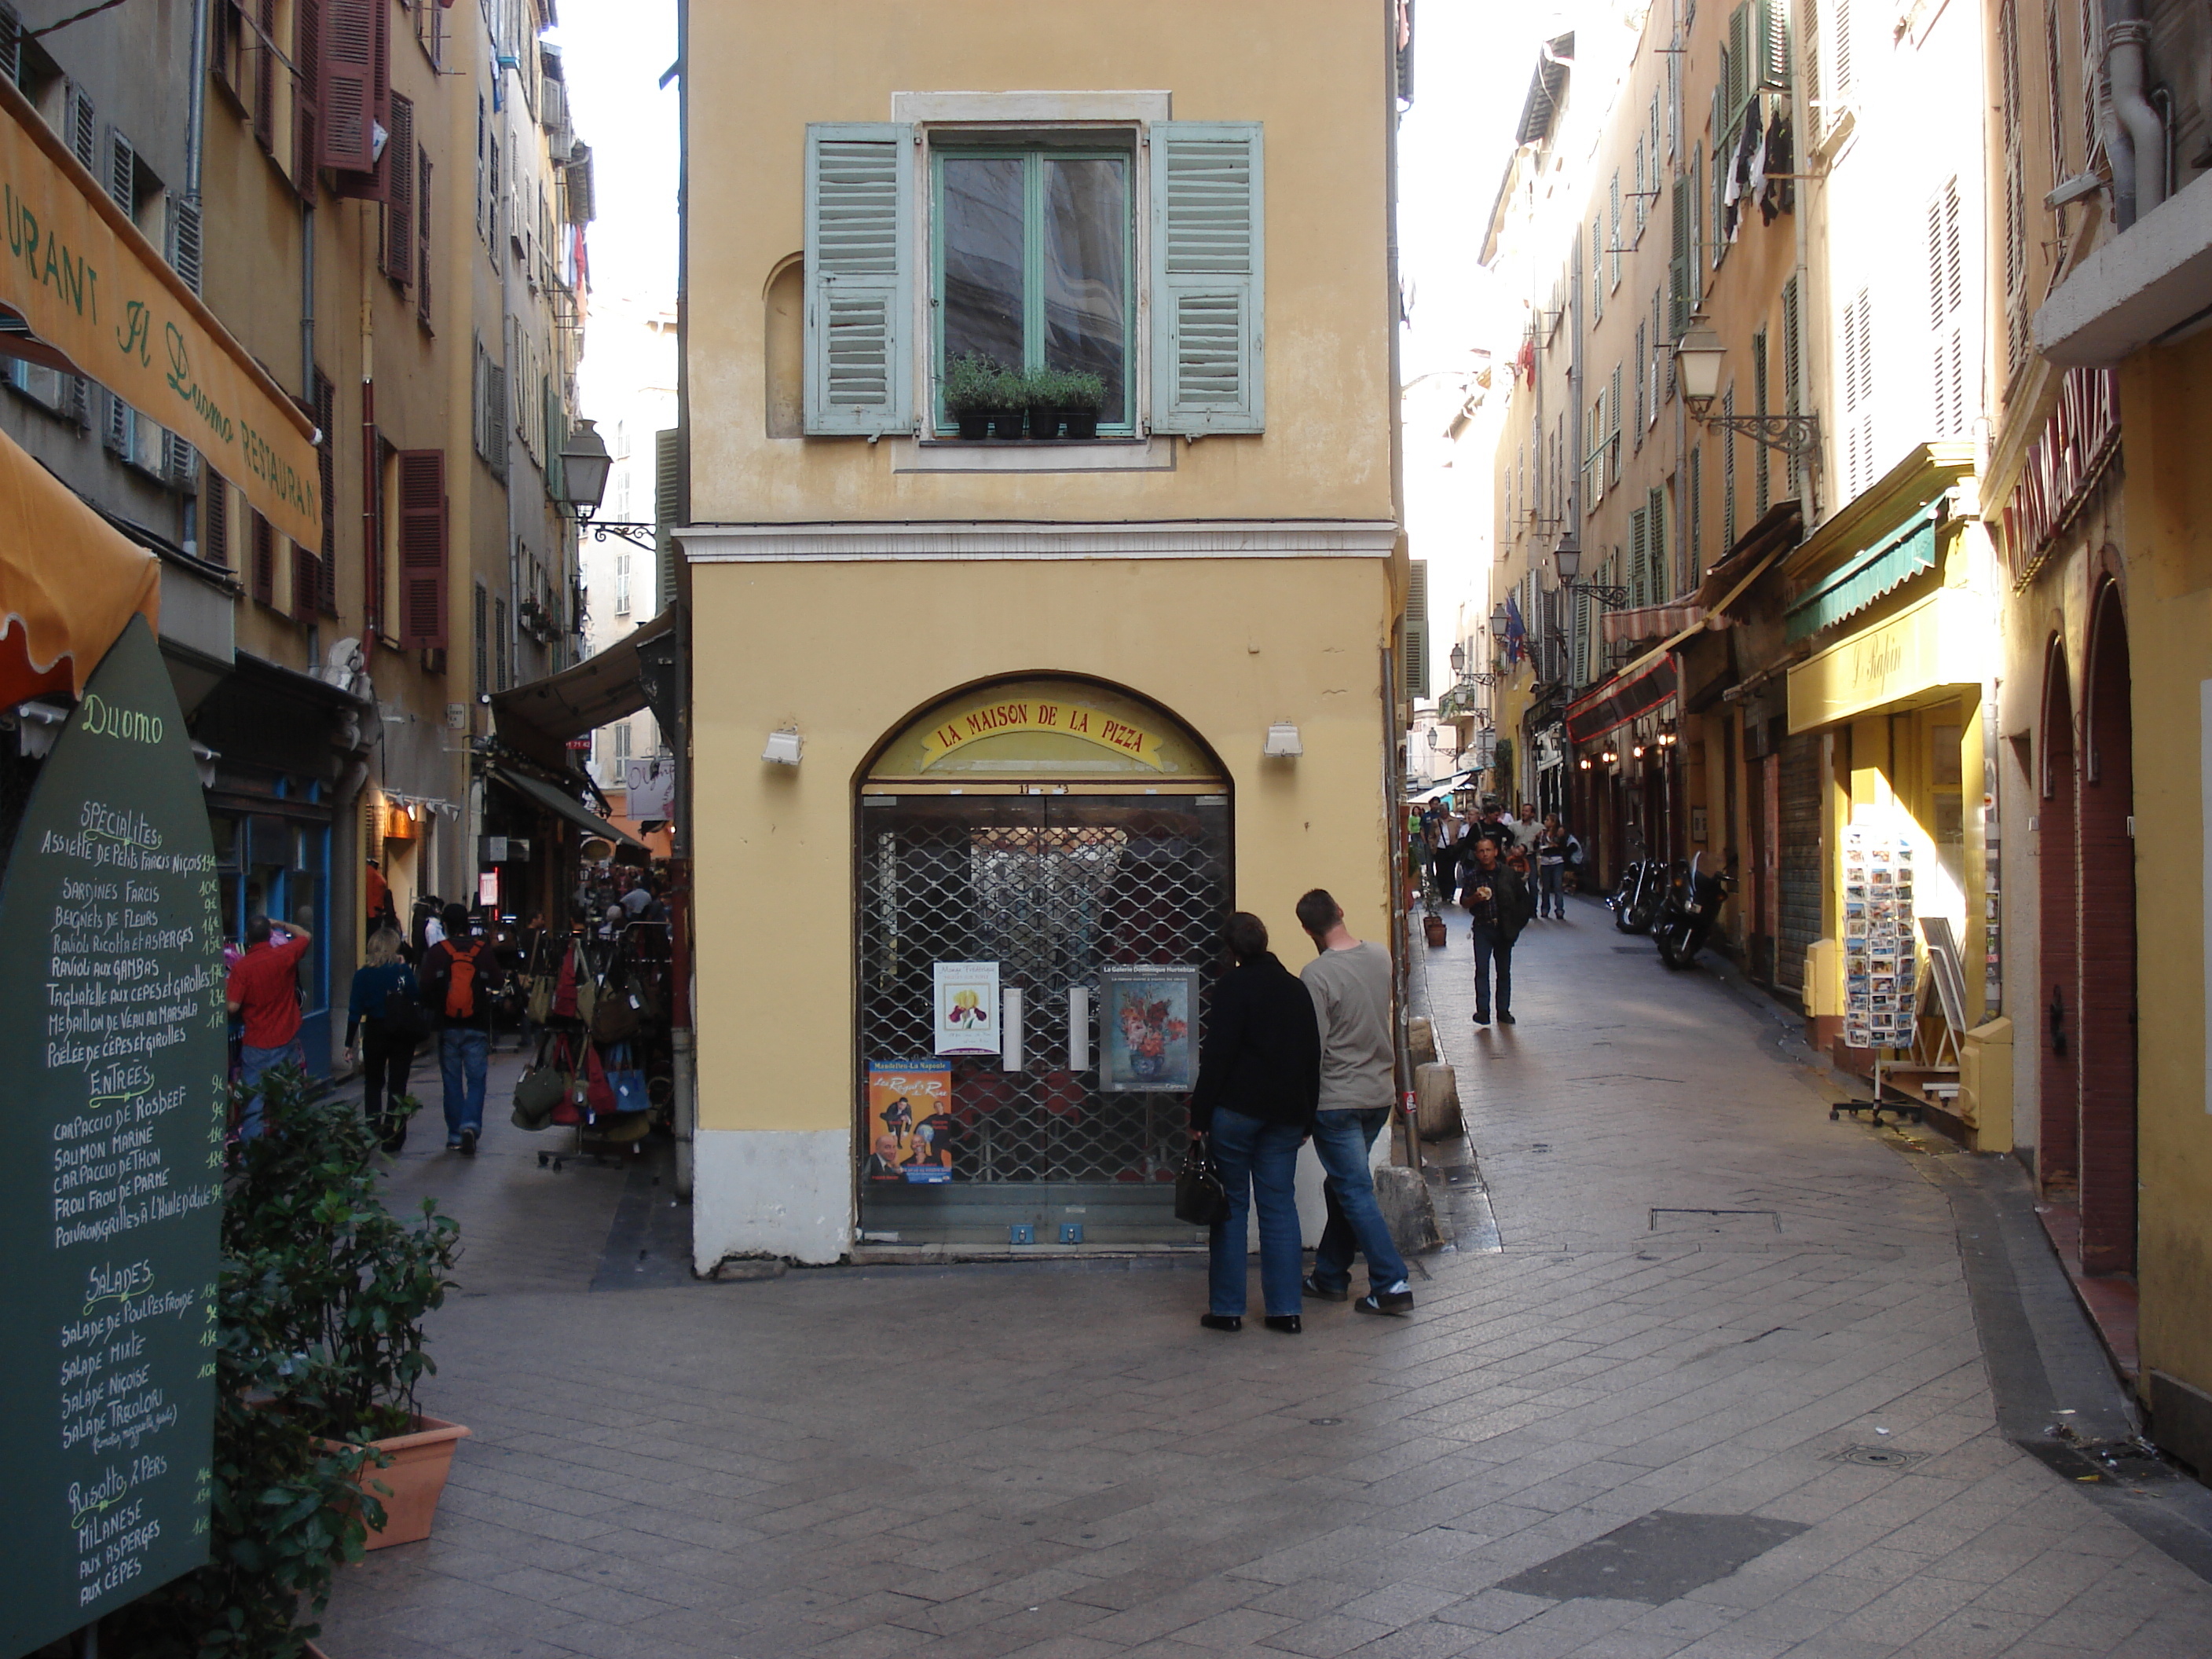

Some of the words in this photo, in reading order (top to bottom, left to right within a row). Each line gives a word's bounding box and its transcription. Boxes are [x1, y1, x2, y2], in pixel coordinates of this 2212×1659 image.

[0, 183, 97, 326] URANT
[166, 320, 234, 444] Duomo
[937, 723, 962, 748] LA
[966, 704, 1027, 735] MAISON
[1038, 705, 1058, 726] DE
[1069, 710, 1089, 733] LA
[1101, 720, 1144, 753] PIZZA
[96, 843, 110, 867] DE
[141, 851, 170, 872] FARCIS
[63, 877, 118, 909] SARDINES
[126, 879, 159, 903] FARCIS
[199, 879, 218, 896] 10€
[51, 904, 103, 936] BEIGNETS
[104, 911, 119, 936] DE
[124, 909, 159, 928] FLEURS
[53, 933, 90, 954] RAVIOLI
[93, 930, 130, 954] RICOTTA
[145, 926, 193, 952] ASPERGES
[46, 982, 108, 1011] TAGLIATELLE
[110, 991, 129, 1005] AUX
[174, 964, 211, 1002] GIROLLES
[52, 956, 90, 978] RAVIOLI
[93, 961, 112, 977] AUX
[113, 958, 159, 985] GAMBAS
[49, 1008, 104, 1042] MEDAILLON
[104, 1014, 119, 1042] DE
[121, 1006, 145, 1031] VEAU
[146, 1010, 158, 1027] AU
[159, 998, 197, 1024] MARSALA
[83, 1046, 101, 1072] DE
[145, 1024, 186, 1058] GIROLLES
[53, 1115, 112, 1141] CARPACCIO
[114, 1104, 131, 1135] DE
[53, 1163, 116, 1195] CARPACCIO
[118, 1159, 132, 1184] DE
[129, 1148, 161, 1171] THON
[54, 1141, 106, 1172] SAUMON
[54, 1196, 86, 1221] FROU
[89, 1187, 116, 1211] FROU
[119, 1181, 132, 1207] DE
[134, 1167, 170, 1196] PARME
[86, 1258, 151, 1302] SALADES
[61, 1317, 104, 1348] SALADE
[103, 1312, 121, 1344] DE
[123, 1294, 163, 1324] POULPES
[60, 1351, 104, 1390] SALADE
[110, 1329, 147, 1364] MIXTE
[61, 1382, 104, 1420] SALADE
[63, 1412, 107, 1449] SALADE
[141, 1455, 167, 1481] PERS
[79, 1497, 143, 1555] MILANESE
[79, 1552, 102, 1580] AUX
[106, 1518, 161, 1566] ASPERGES
[80, 1577, 103, 1607] AUX
